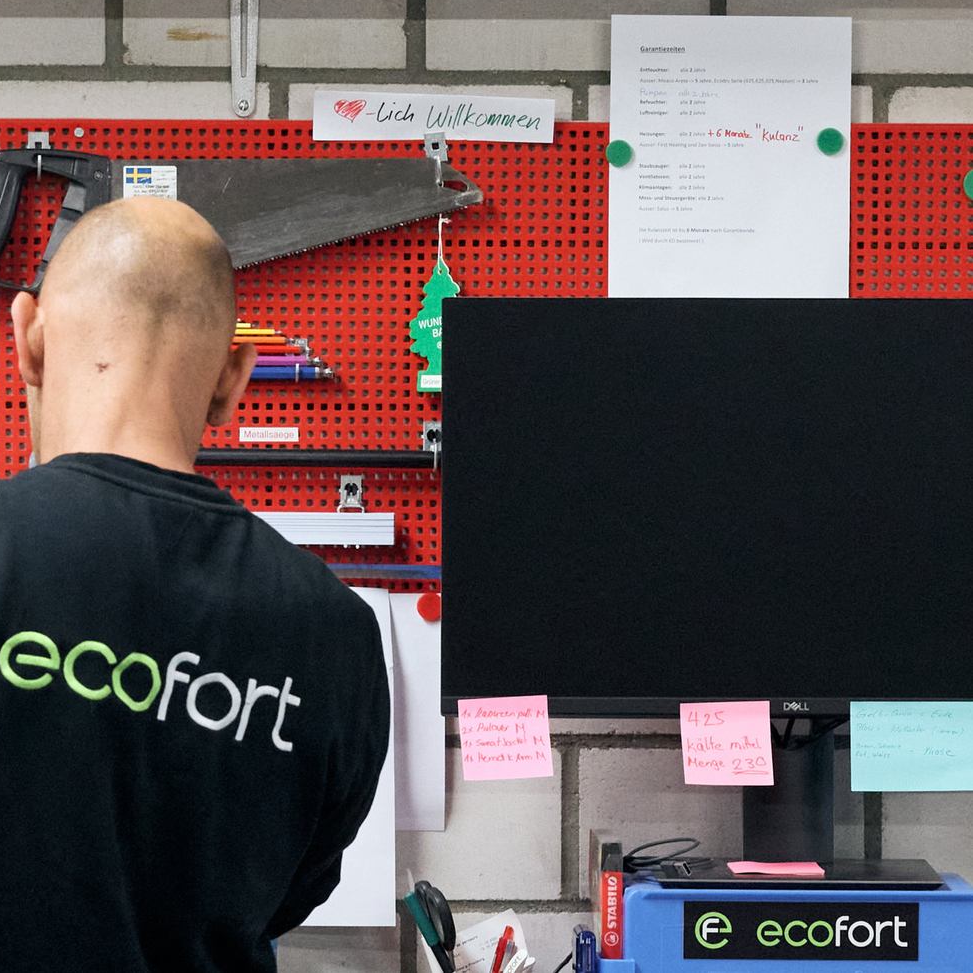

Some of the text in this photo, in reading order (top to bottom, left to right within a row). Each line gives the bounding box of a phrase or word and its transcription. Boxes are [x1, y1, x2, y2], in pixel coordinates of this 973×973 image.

[640, 46, 685, 54] Garantiezeiten
[426, 103, 541, 130] Willkommen
[716, 128, 722, 137] 6
[244, 430, 294, 439] Metallsaege
[783, 701, 809, 711] DELL
[535, 710, 545, 718] M
[515, 723, 526, 734] M
[533, 735, 546, 746] M
[535, 750, 547, 761] M
[687, 756, 767, 771] Menge 230
[757, 915, 908, 947] ecofort
